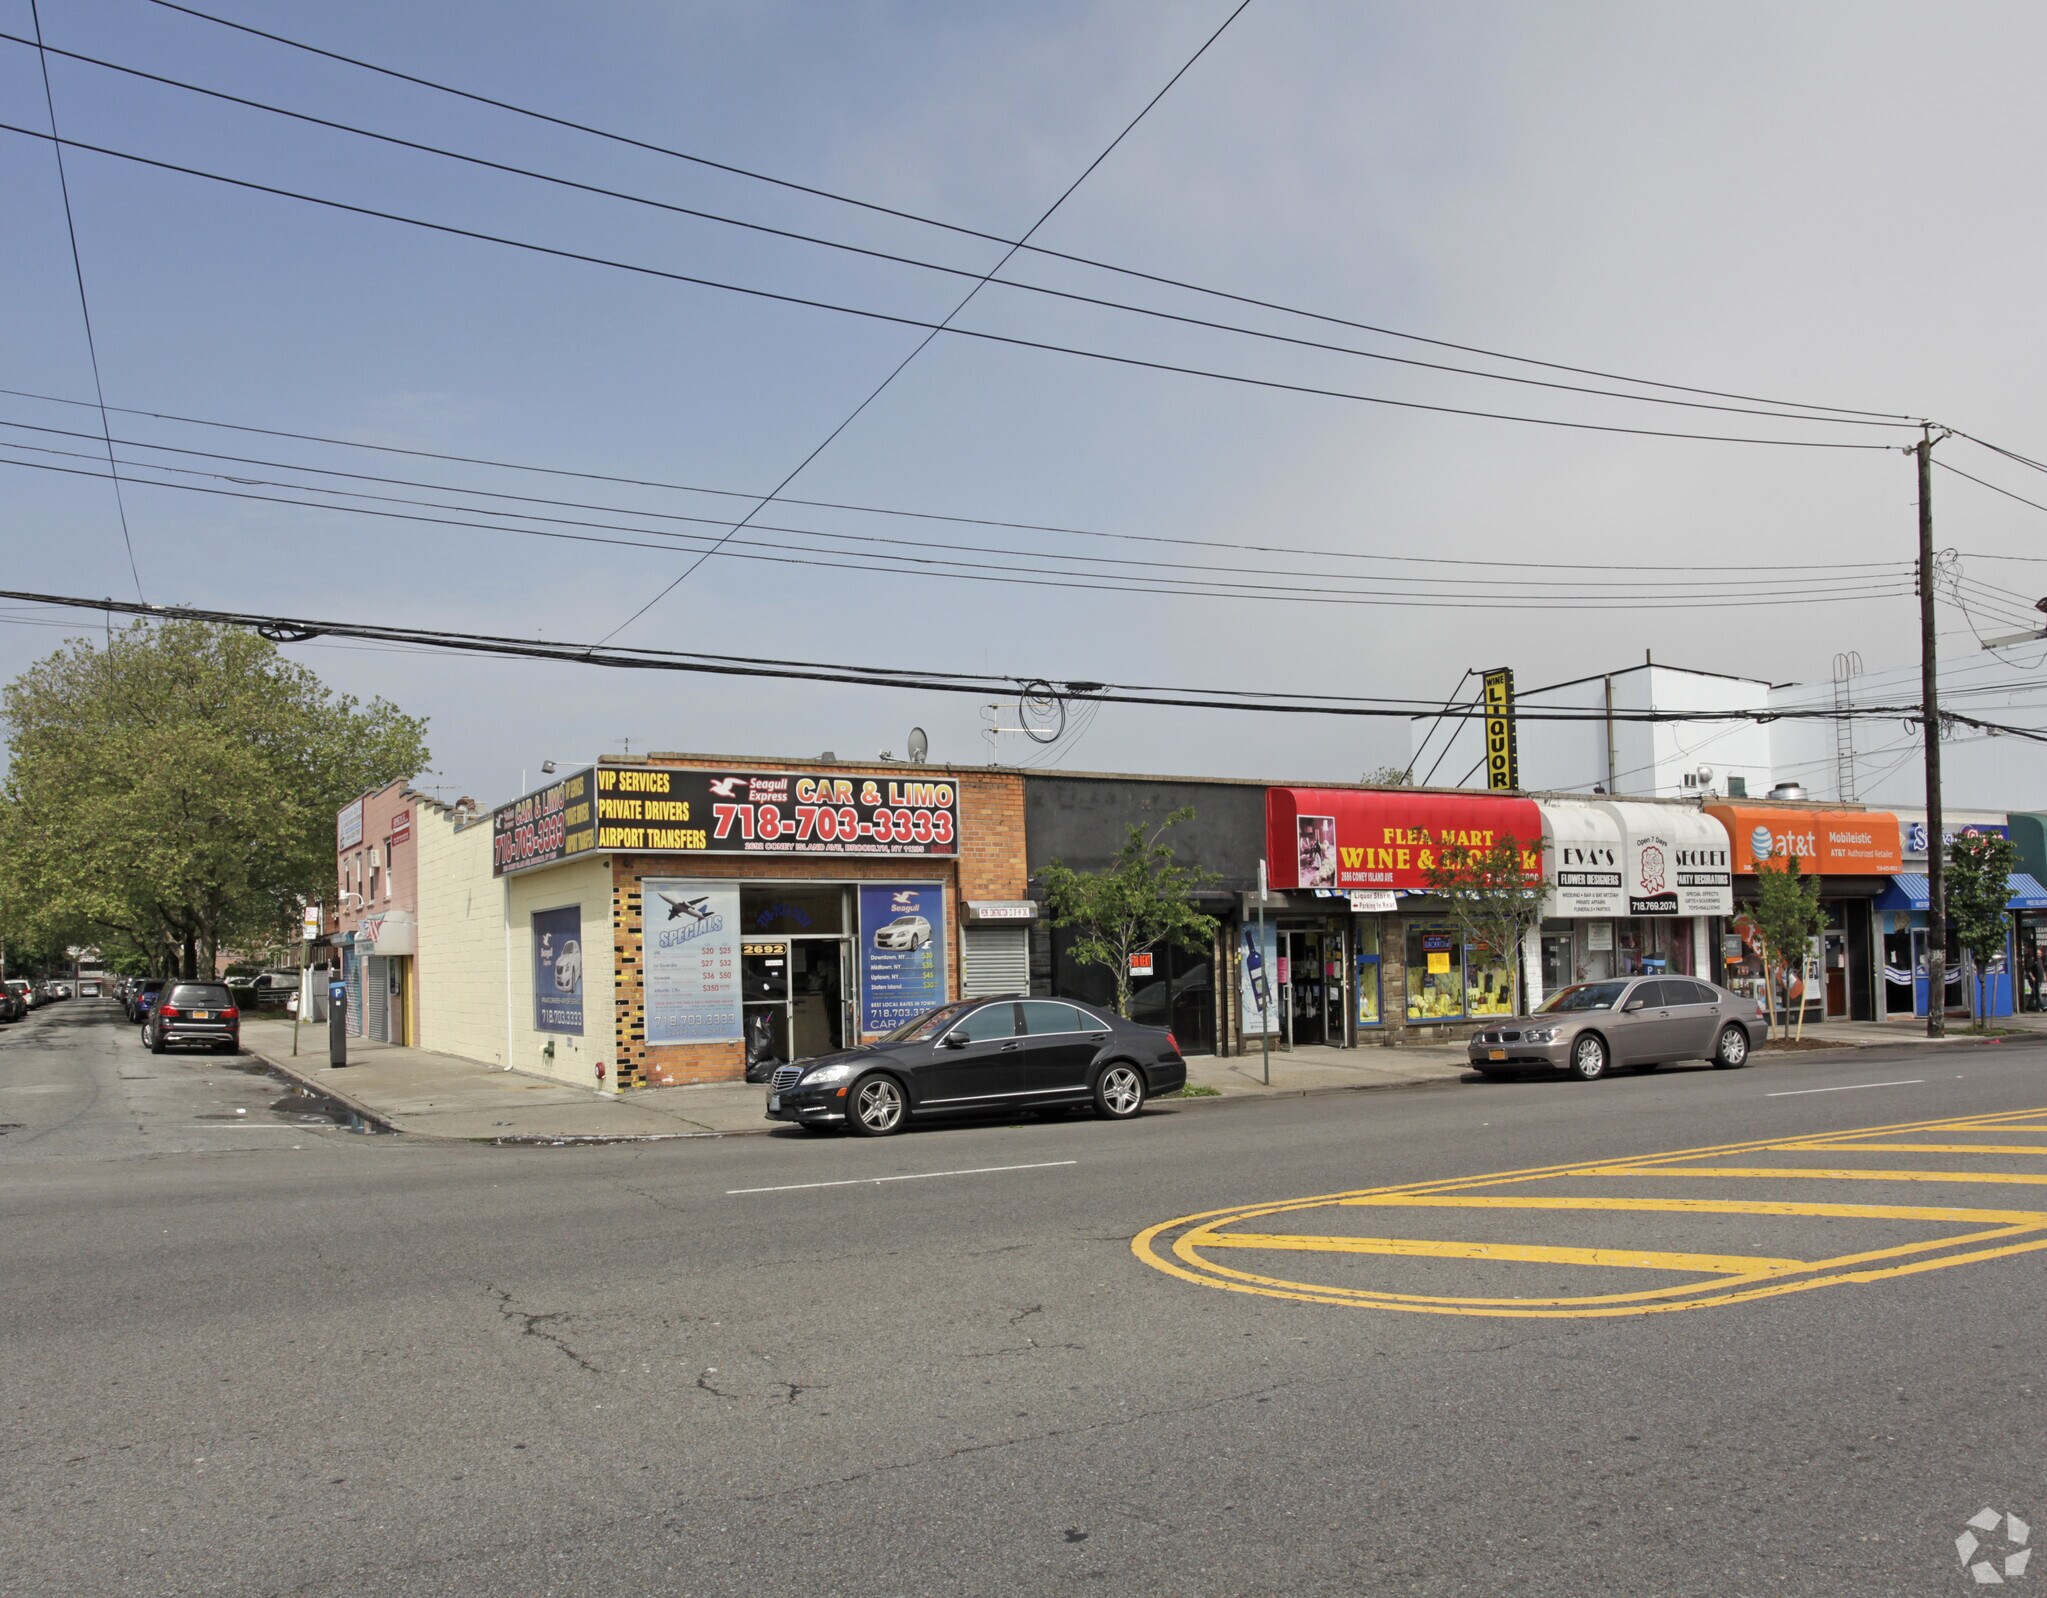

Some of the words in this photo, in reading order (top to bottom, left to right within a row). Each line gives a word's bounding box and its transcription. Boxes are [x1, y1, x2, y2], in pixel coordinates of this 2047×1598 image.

[1486, 675, 1504, 687] WINE
[1489, 688, 1508, 788] LIQUOR
[598, 770, 617, 791] VIP
[619, 772, 670, 793] SERVICES
[749, 777, 788, 790] Seagull
[748, 790, 788, 804] Express
[796, 778, 853, 805] CAR
[860, 781, 882, 806] &
[888, 782, 954, 808] LIMO
[515, 799, 533, 826] CAR
[534, 795, 541, 819] &
[542, 784, 565, 816] LIMO
[598, 798, 643, 820] PRIVATE
[644, 801, 690, 822] DRIVERS
[713, 803, 953, 844] 718-703-3333
[495, 812, 565, 866] 718-703-3333
[598, 827, 645, 848] AIRPORT
[647, 829, 707, 850] TRANSFERS
[1383, 828, 1433, 845] FLEA
[1441, 829, 1494, 846] MART
[1637, 837, 1650, 846] Open
[1656, 837, 1667, 847] Days
[1829, 832, 1872, 844] Mobileistic
[744, 842, 764, 850] 2692
[765, 842, 794, 851] CONEY
[795, 843, 825, 851] ISLAND
[826, 844, 844, 853] AVE,
[845, 844, 890, 853] BROOKLYN,
[1775, 830, 1817, 857] at&t
[1339, 847, 1410, 869] WINE
[1417, 848, 1436, 870] &
[1563, 848, 1615, 866] EVA'S
[1675, 849, 1727, 866] SECRET
[1847, 849, 1874, 857] Authorized
[1874, 850, 1893, 858] Retailer
[1352, 872, 1367, 882] CONEY
[1368, 872, 1384, 882] ISLAND
[1385, 872, 1393, 882] AVE
[1561, 873, 1586, 885] FLOWER
[1586, 874, 1619, 886] DESIGNERS
[1695, 874, 1728, 885] DECORATORS
[1354, 891, 1373, 900] Liquor
[891, 904, 920, 913] Seagull
[1360, 902, 1376, 910] Parking
[1632, 901, 1677, 911] 718.769.2074
[659, 914, 723, 948] SPECIALS
[701, 947, 714, 955] $20
[719, 946, 731, 955] $25
[743, 945, 784, 953] 2692
[701, 959, 713, 967] $27
[719, 959, 732, 967] $32
[1139, 954, 1151, 967] RENT
[702, 972, 715, 980] $36
[335, 988, 341, 998] P
[702, 984, 719, 992] $350
[654, 1013, 735, 1027] 718.703.3333
[870, 1019, 896, 1029] CAR
